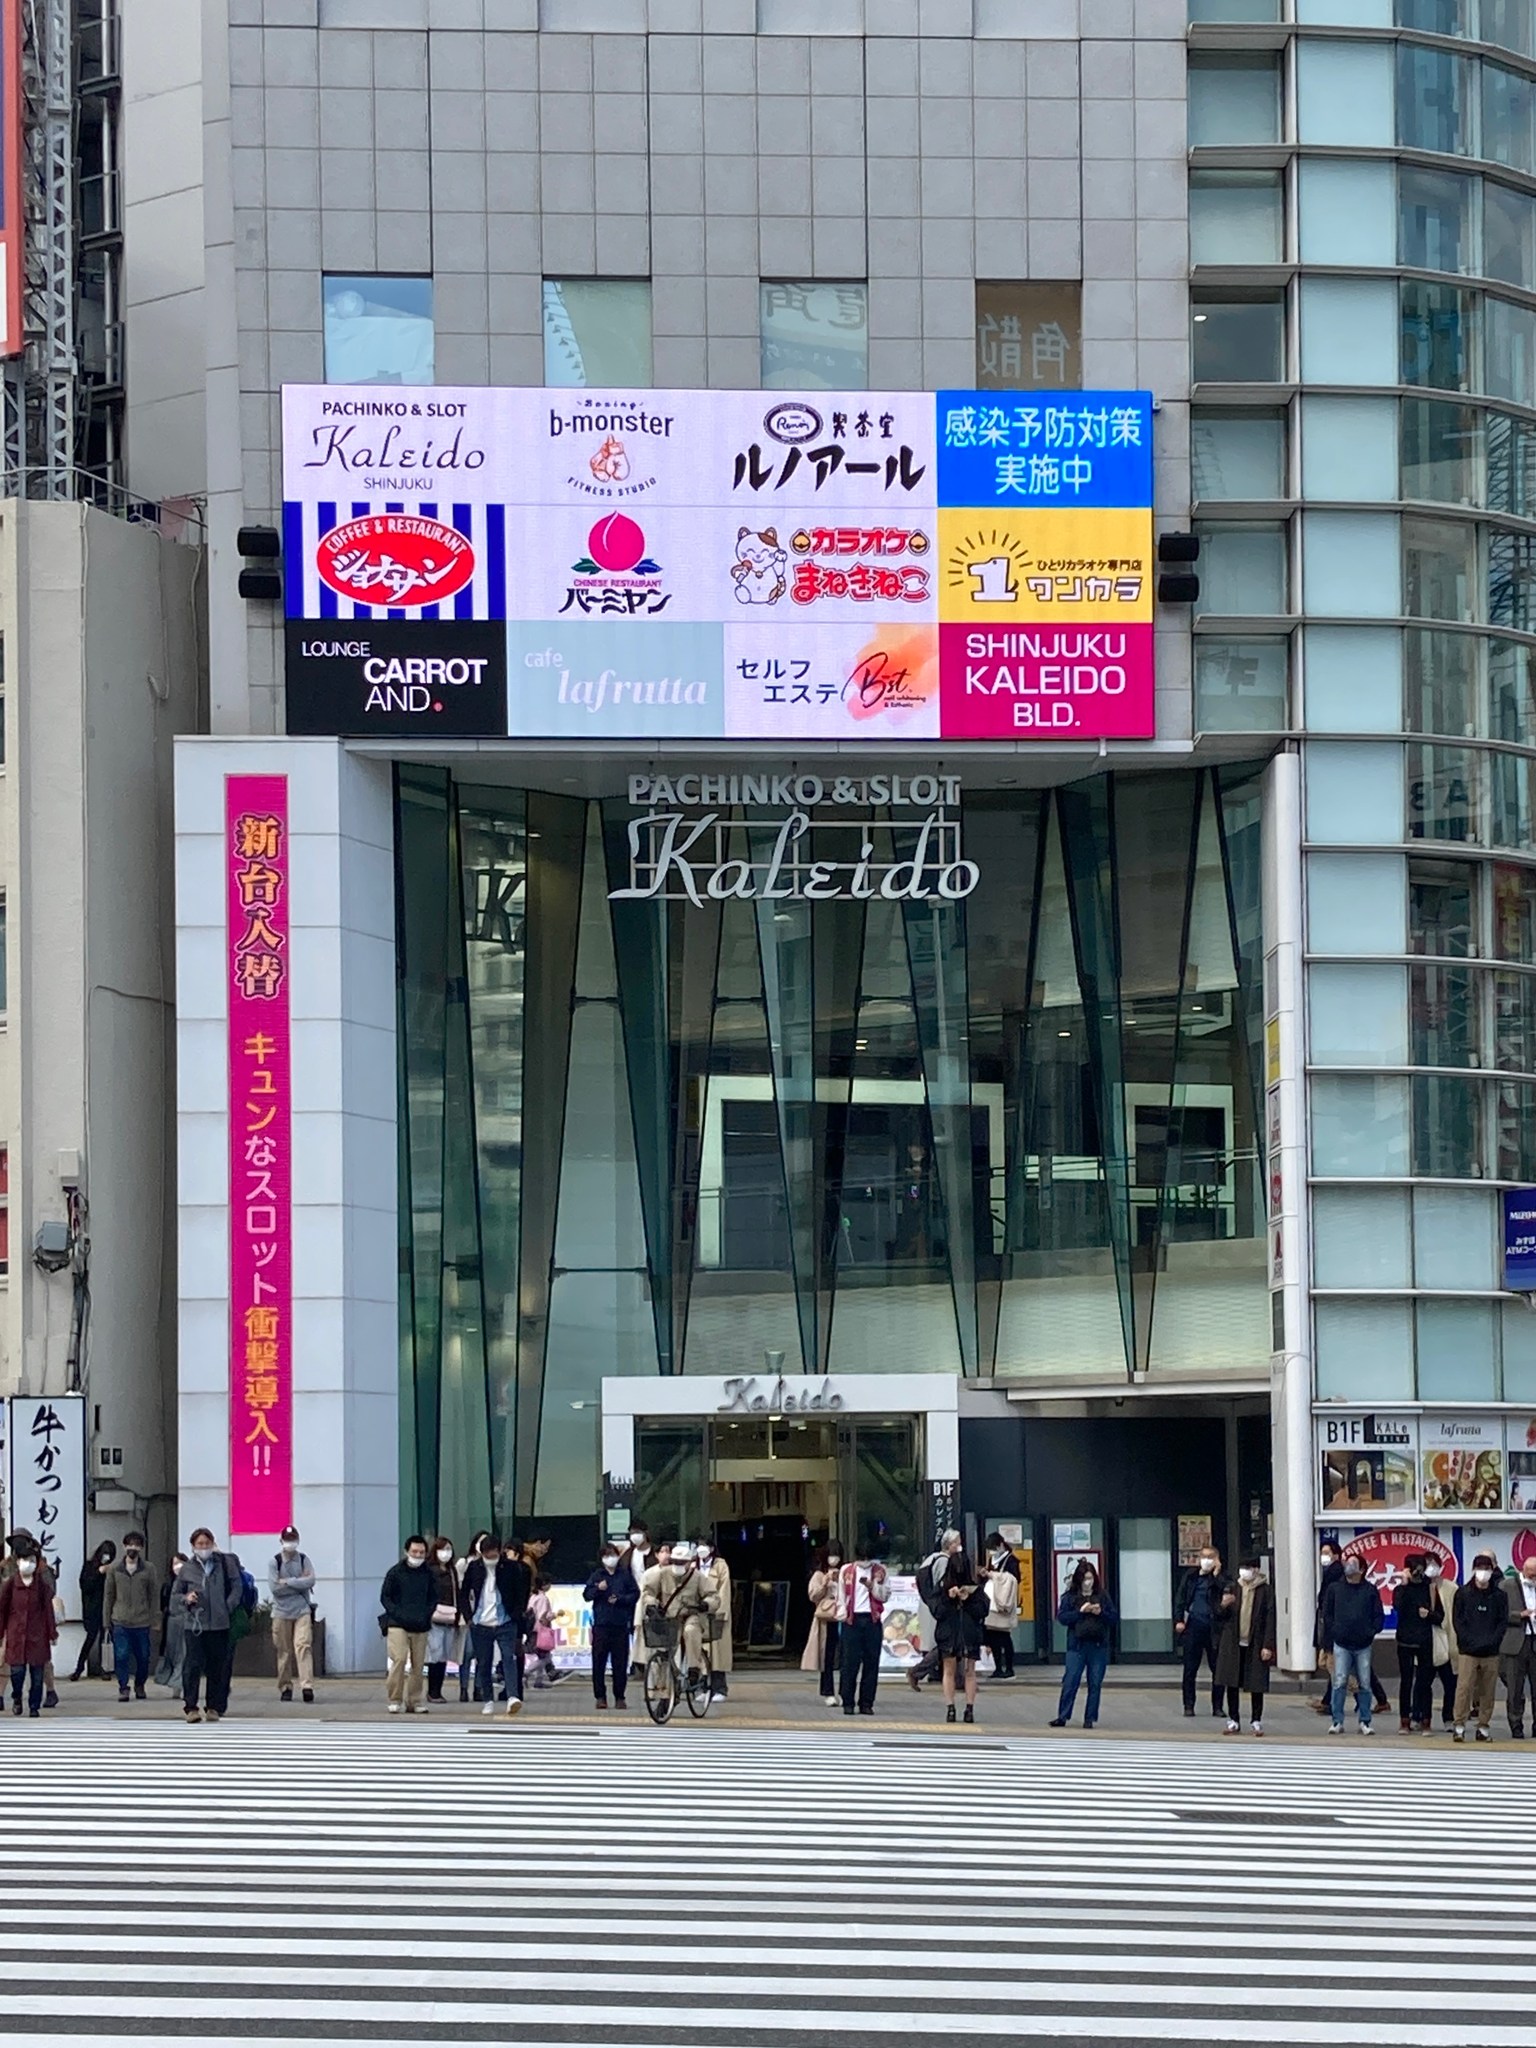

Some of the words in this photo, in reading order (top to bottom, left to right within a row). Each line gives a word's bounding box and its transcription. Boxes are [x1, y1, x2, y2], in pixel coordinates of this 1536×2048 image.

[322, 401, 408, 417] PACHINKO
[410, 403, 422, 417] &
[426, 403, 468, 418] SLOT
[550, 408, 675, 437] b-monster
[832, 409, 895, 440] 喫茶室
[944, 406, 1142, 449] 感染予防対策
[303, 425, 485, 472] Kaleido
[732, 443, 926, 491] ルノアール
[995, 453, 1092, 496] 実施中
[363, 476, 434, 490] SHINJUKU
[567, 476, 612, 497] FITNESS
[617, 476, 657, 496] STUDIO
[324, 520, 370, 554] COFFEE
[374, 518, 384, 535] &
[387, 518, 468, 555] RESTAURANT
[811, 527, 909, 555] カラオケ
[330, 549, 459, 603] ジョナサン
[1036, 558, 1143, 572] ひとりカラオケ専門店
[573, 579, 608, 588] CHINESE
[610, 579, 662, 588] RESTAURANT
[790, 561, 931, 604] まねきねこ
[1026, 576, 1143, 603] ワンカラ
[558, 588, 672, 614] バーミヤン
[301, 641, 371, 657] LOUNGE
[524, 649, 564, 668] cafe
[965, 633, 1127, 658] SHINJUKU
[364, 657, 488, 684] CARROT
[736, 658, 811, 681] セルフ
[965, 665, 1127, 695] KALEIDO
[557, 669, 708, 713] lafrutta
[763, 683, 839, 704] エステ
[1013, 703, 1081, 727] BLD.
[627, 774, 824, 806] PACHINKO
[831, 775, 858, 805] &
[868, 774, 962, 806] SLOT
[606, 811, 981, 910] Kaleido
[235, 815, 284, 999] 新台入替
[717, 1376, 844, 1412] Kaleido
[1327, 1420, 1361, 1444] B1F
[933, 1481, 955, 1497] B1F
[1380, 1533, 1388, 1546] &
[1391, 1533, 1451, 1563] RESTAURANT
